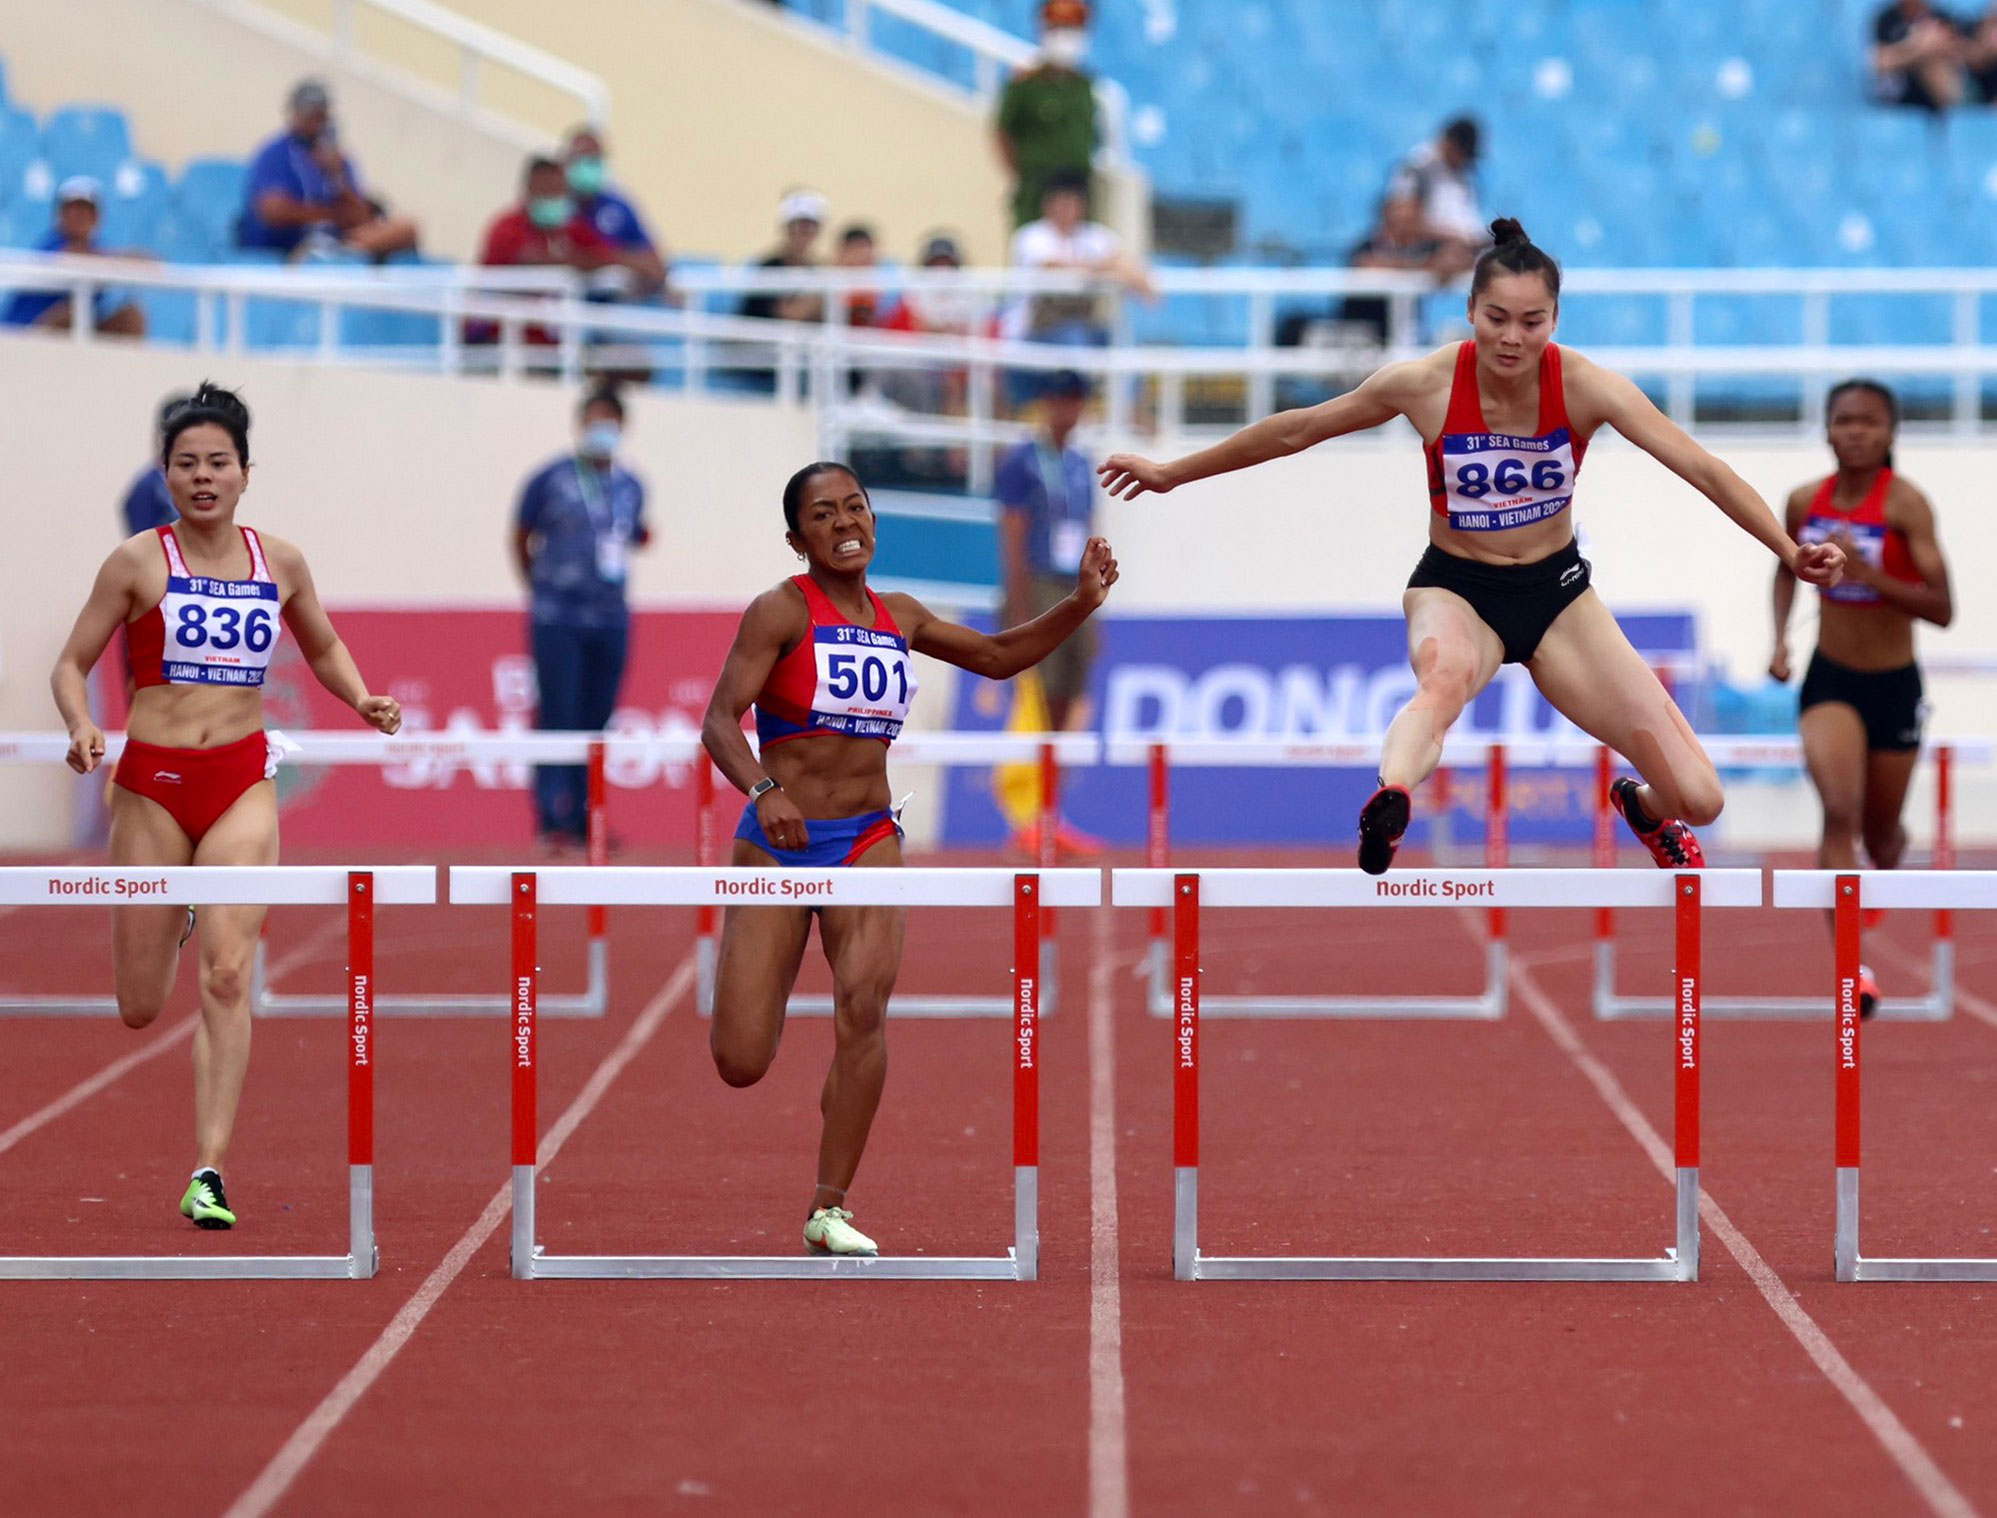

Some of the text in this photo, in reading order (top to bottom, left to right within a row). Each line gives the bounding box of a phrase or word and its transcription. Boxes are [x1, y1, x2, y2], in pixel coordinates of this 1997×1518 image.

[1488, 435, 1510, 448] SEA
[1512, 438, 1550, 451] Games
[1456, 458, 1565, 499] 866
[1458, 514, 1491, 528] HANOI
[1499, 505, 1542, 527] VIETNAM
[1543, 500, 1566, 515] 202
[1492, 496, 1533, 509] VIETNAM
[208, 580, 226, 596] SEA
[227, 582, 261, 596] Games
[176, 603, 272, 653] 836
[169, 663, 199, 679] HANOI
[207, 667, 248, 682] VIETNAM
[204, 655, 241, 664] VIETNAM
[828, 653, 907, 705] 501
[114, 878, 168, 899] Sport
[780, 879, 834, 899] Sport
[1441, 880, 1495, 901] Sport
[352, 1025, 368, 1066] Sport
[515, 1026, 531, 1067] Sport
[1017, 1027, 1033, 1069] Sport
[1178, 1026, 1193, 1068] Sport
[1679, 1027, 1695, 1069] Sport
[1840, 1027, 1855, 1069] Sport
